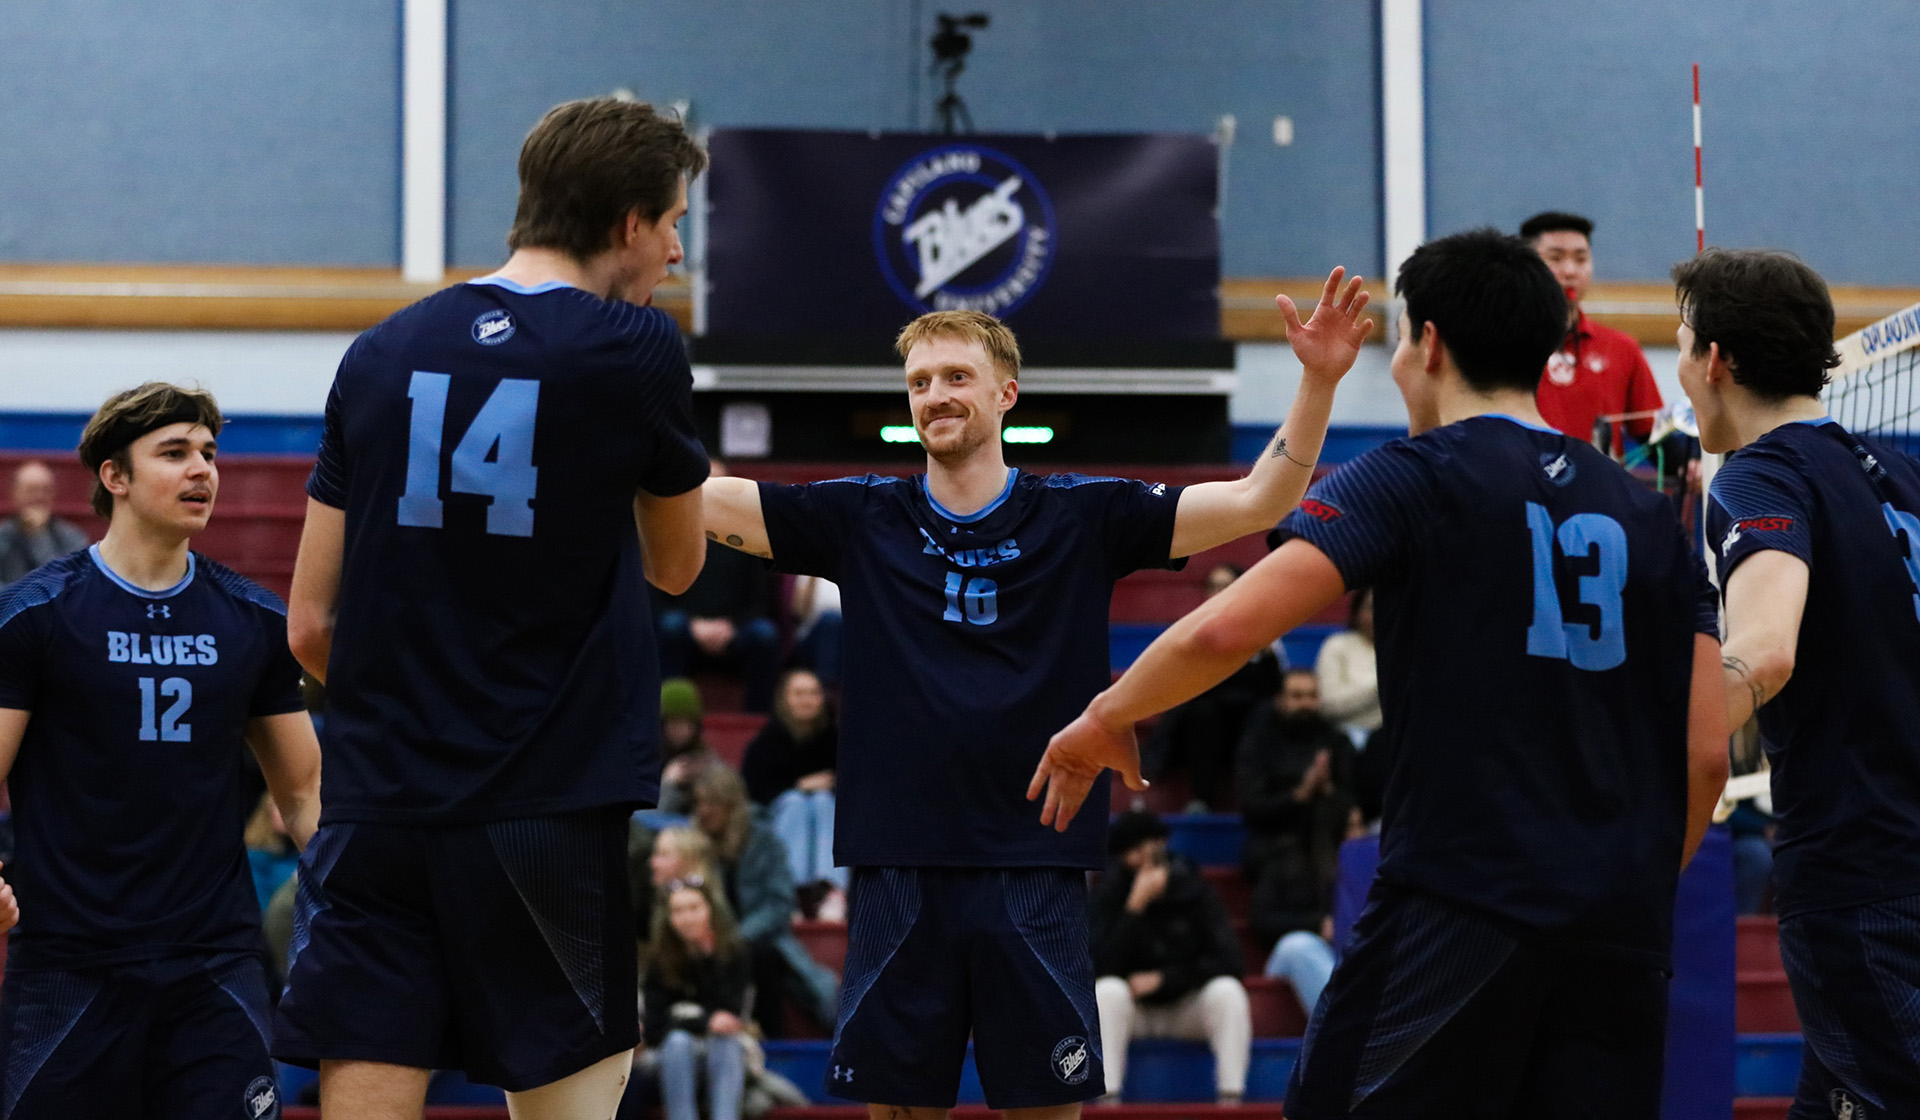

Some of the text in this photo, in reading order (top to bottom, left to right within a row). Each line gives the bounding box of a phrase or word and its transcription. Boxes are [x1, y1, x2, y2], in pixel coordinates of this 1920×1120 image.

[903, 174, 1022, 299] Blues
[397, 370, 541, 538] 14
[1525, 501, 1628, 671] 13
[107, 631, 218, 665] BLUES
[138, 676, 193, 742] 12
[1059, 1042, 1087, 1079] Blues
